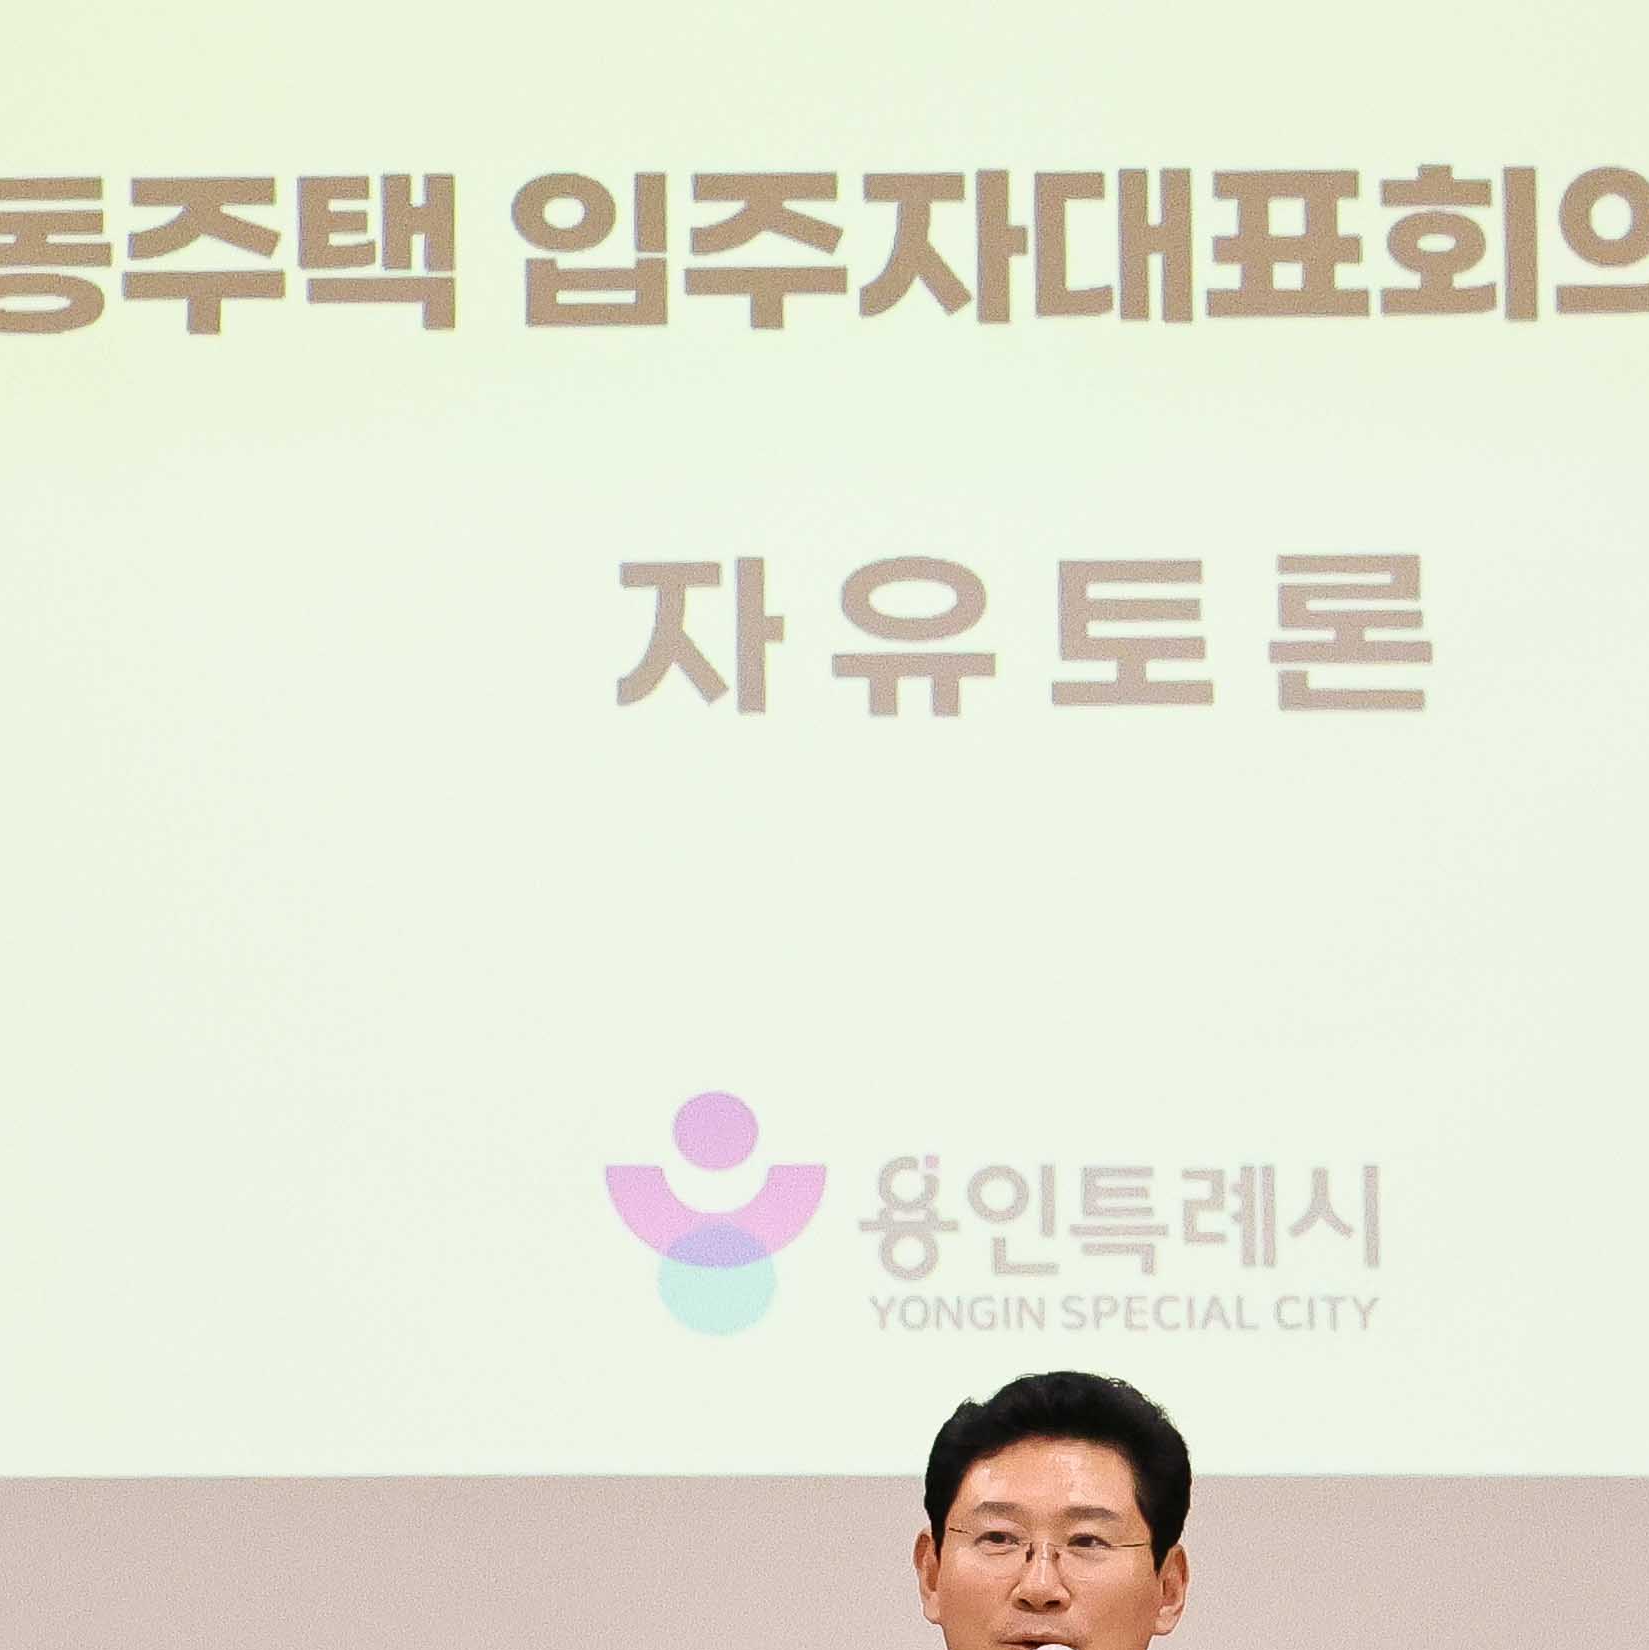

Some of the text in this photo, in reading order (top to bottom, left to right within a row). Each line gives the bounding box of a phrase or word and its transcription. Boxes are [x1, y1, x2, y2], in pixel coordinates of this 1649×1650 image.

[859, 1155, 1382, 1281] 용인특례시
[870, 1295, 1381, 1331] YONGIN SPECIAL CITY
